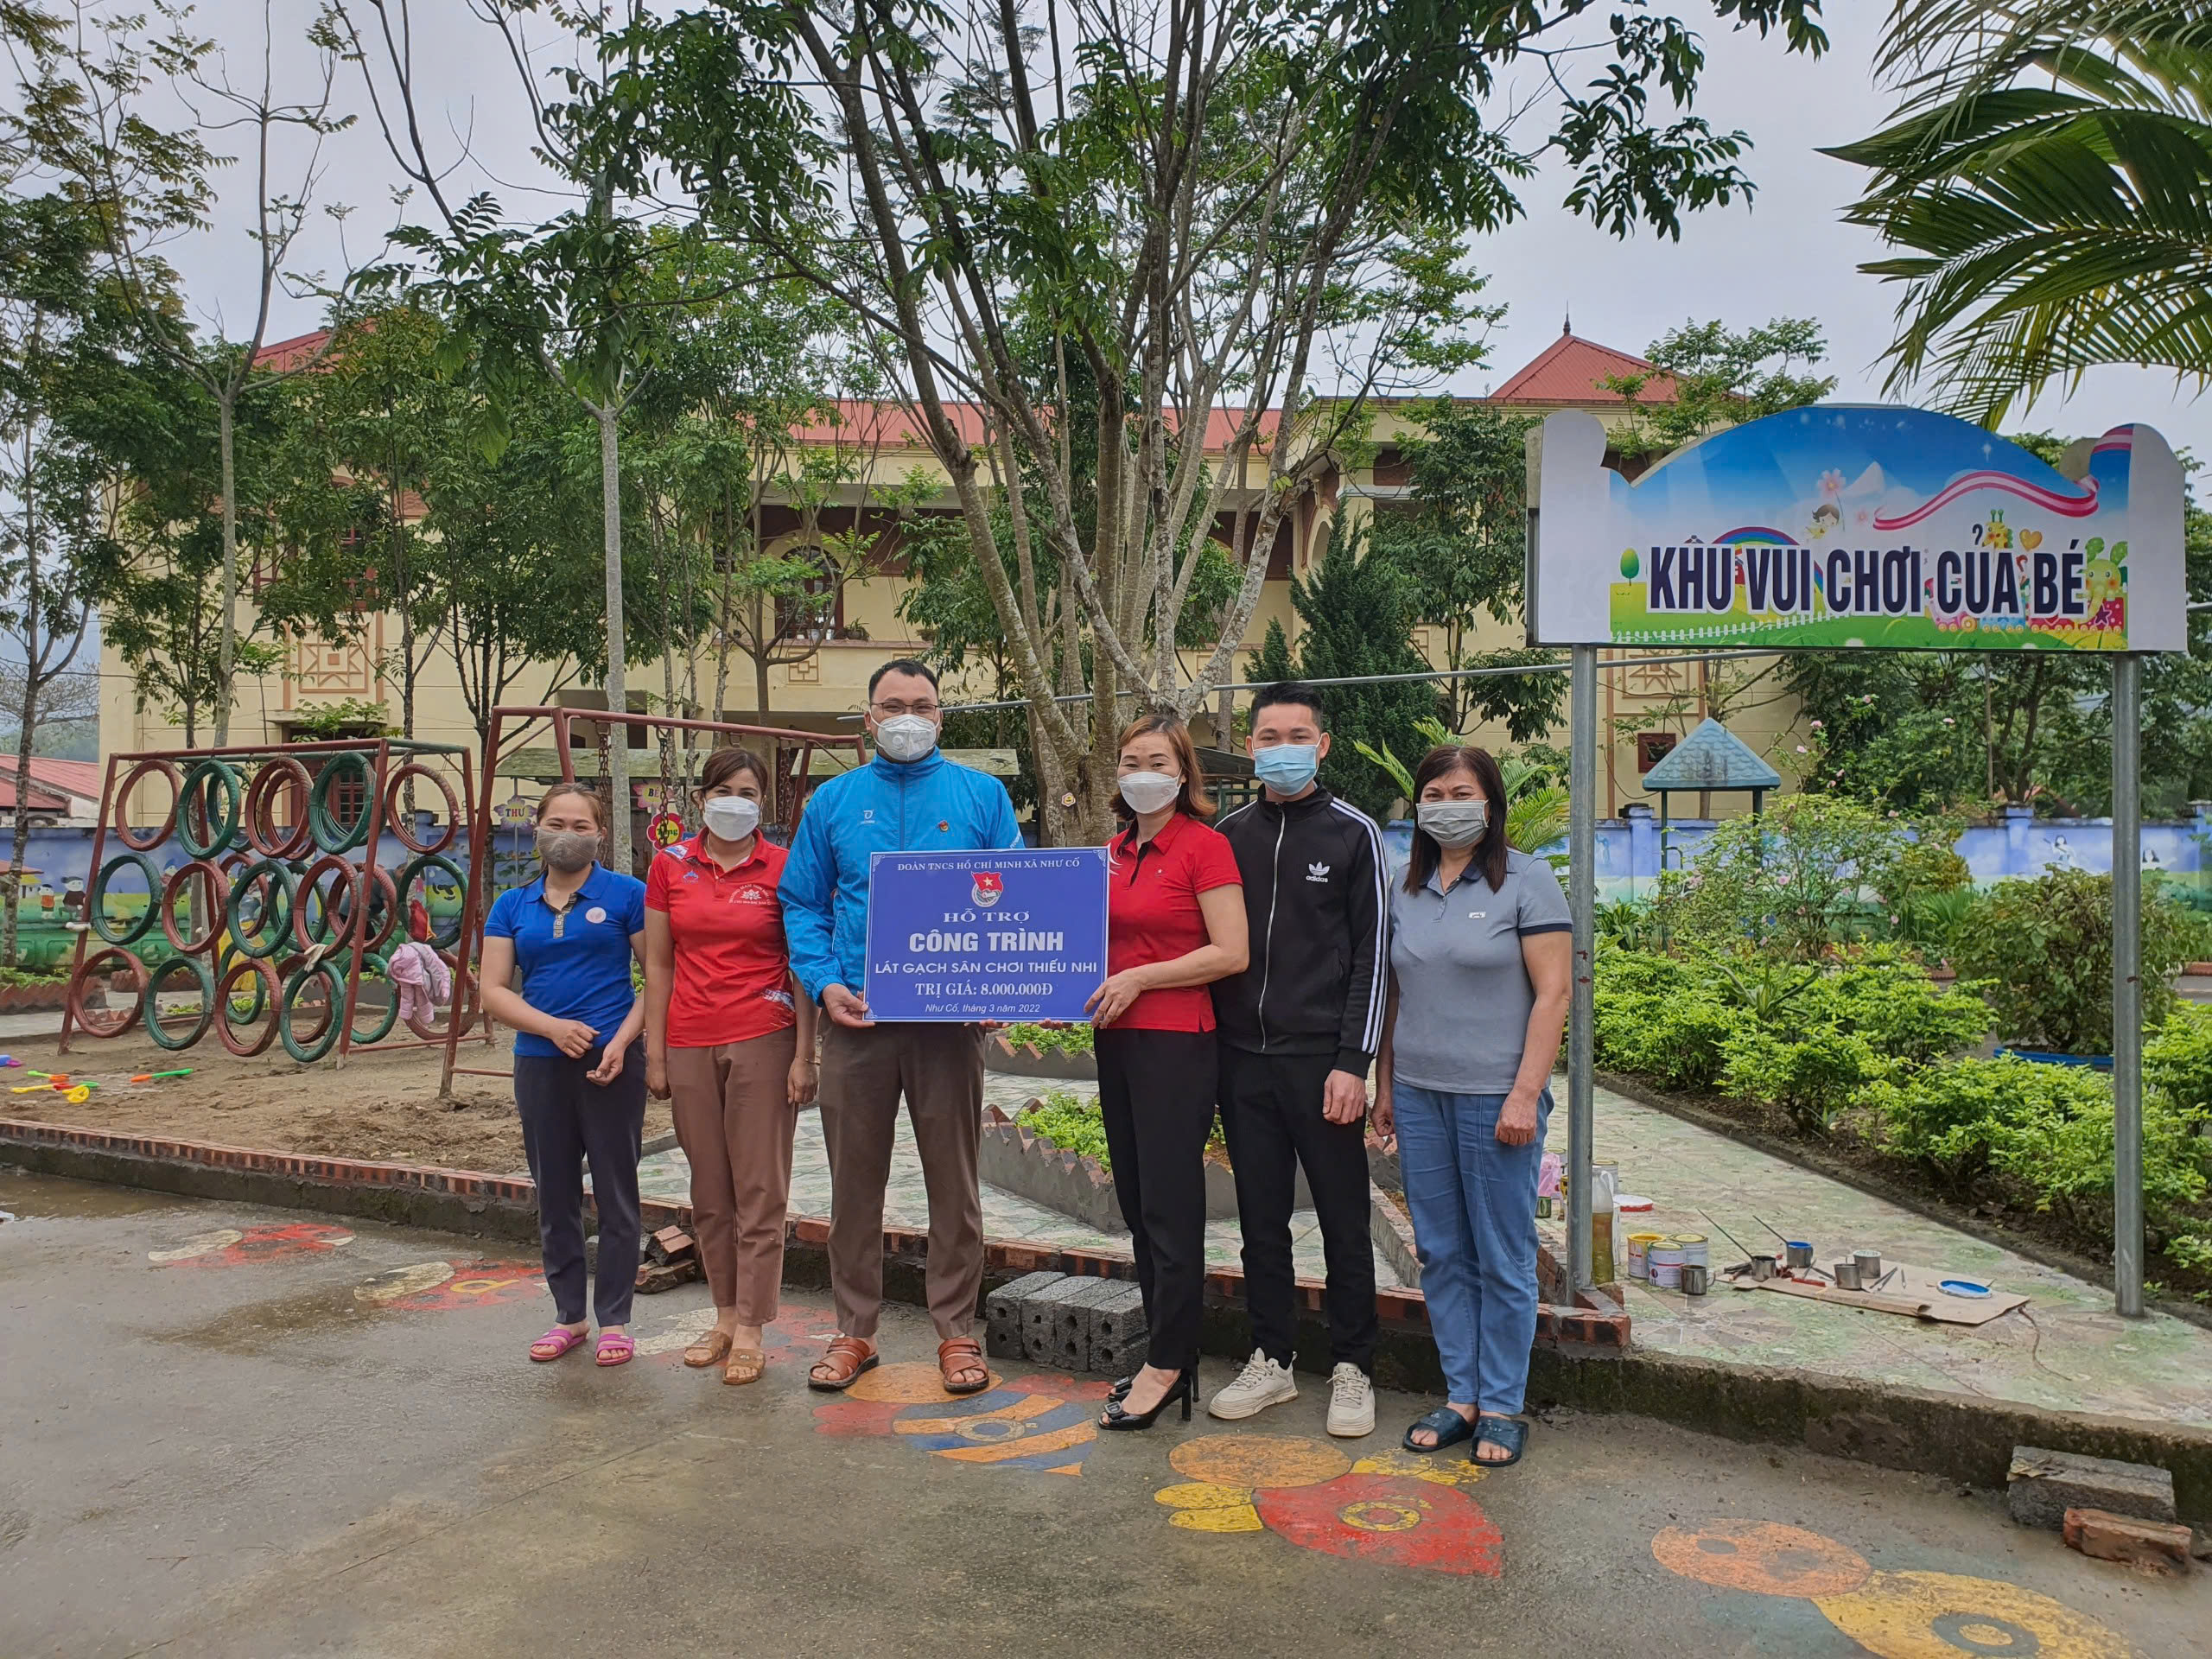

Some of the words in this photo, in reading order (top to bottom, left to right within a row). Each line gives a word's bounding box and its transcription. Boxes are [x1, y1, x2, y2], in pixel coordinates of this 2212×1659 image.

[1649, 546, 1732, 611] KHU
[1745, 547, 1811, 613] VUI
[1826, 545, 1922, 613] CHƠI
[1936, 523, 2020, 614] CỦA
[2033, 538, 2085, 615] BÉ
[505, 806, 525, 817] THƯ
[974, 860, 992, 869] CHÍ
[995, 860, 1022, 869] MINH
[1039, 858, 1065, 868] NHƯ
[943, 908, 976, 923] HỖ
[982, 911, 1030, 924] TRỢ
[909, 929, 979, 952] CÔNG
[987, 927, 1064, 951] TRÌNH
[874, 960, 899, 974] LÁT
[902, 963, 948, 976] GẠCH
[950, 960, 981, 973] SÂN
[985, 962, 1024, 973] CHƠI
[1027, 958, 1067, 973] THIẾU
[1071, 962, 1097, 973] NHI
[915, 982, 942, 998] TRỊ
[945, 979, 977, 995] GIÁ:
[980, 982, 1053, 995] 8.000.000Đ
[925, 1003, 944, 1013] Như
[962, 1003, 987, 1014] tháng
[988, 1004, 995, 1013] 3
[996, 1004, 1016, 1013] năm
[1018, 1004, 1041, 1013] 2022
